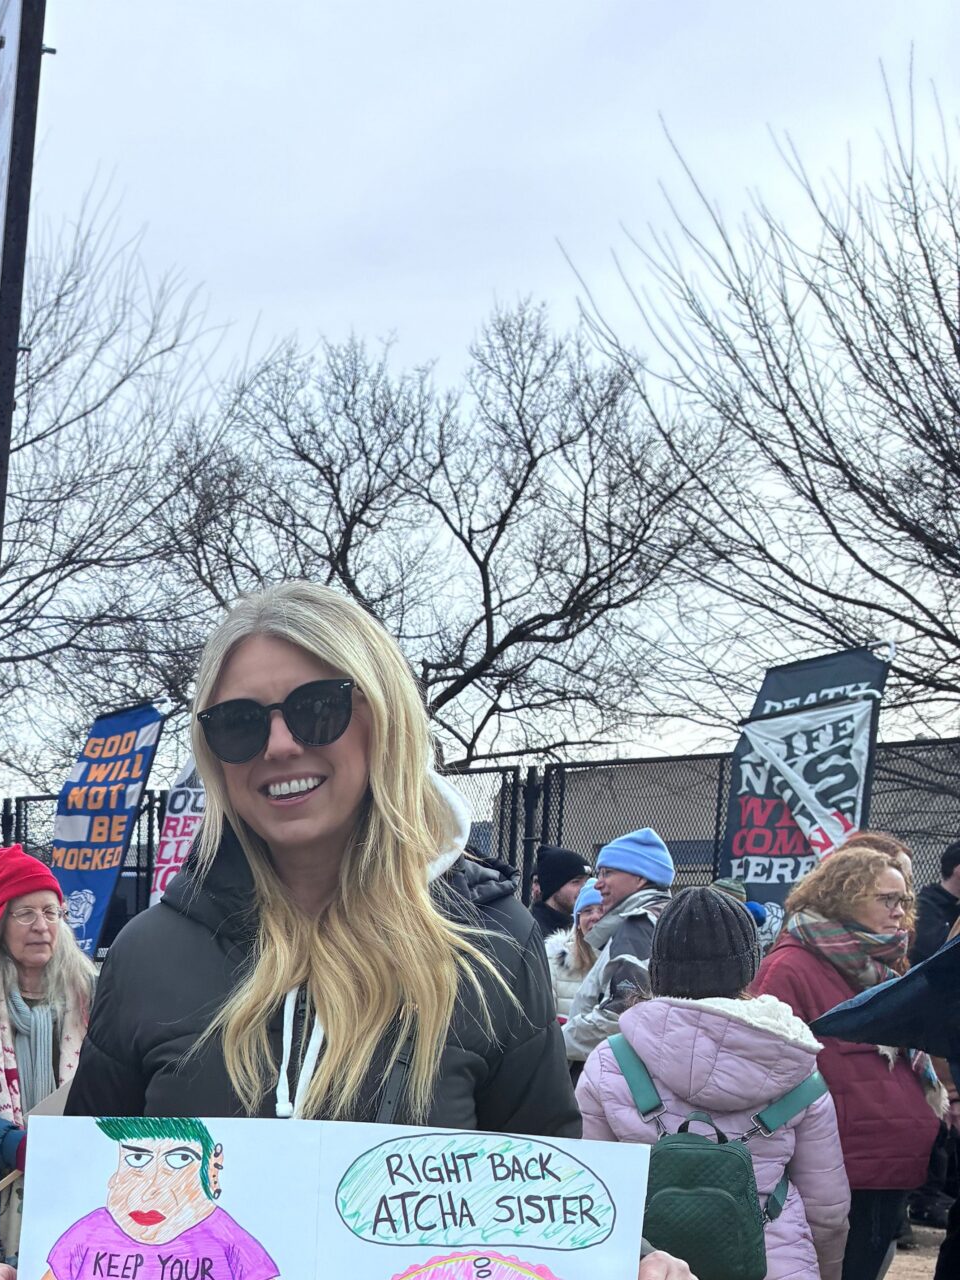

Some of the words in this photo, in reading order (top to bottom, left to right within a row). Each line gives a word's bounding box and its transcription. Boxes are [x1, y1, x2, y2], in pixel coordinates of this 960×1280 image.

[84, 730, 138, 759] GOD
[86, 754, 143, 783] WILL
[67, 783, 125, 810] NOT
[90, 815, 128, 843] BE
[732, 827, 815, 857] COM
[52, 846, 123, 870] MOCKED
[385, 1152, 478, 1186] RIGHT
[488, 1152, 561, 1183] BACK
[372, 1190, 476, 1235] ATCHA
[493, 1194, 601, 1228] SISTER
[92, 1251, 144, 1280] KEEP
